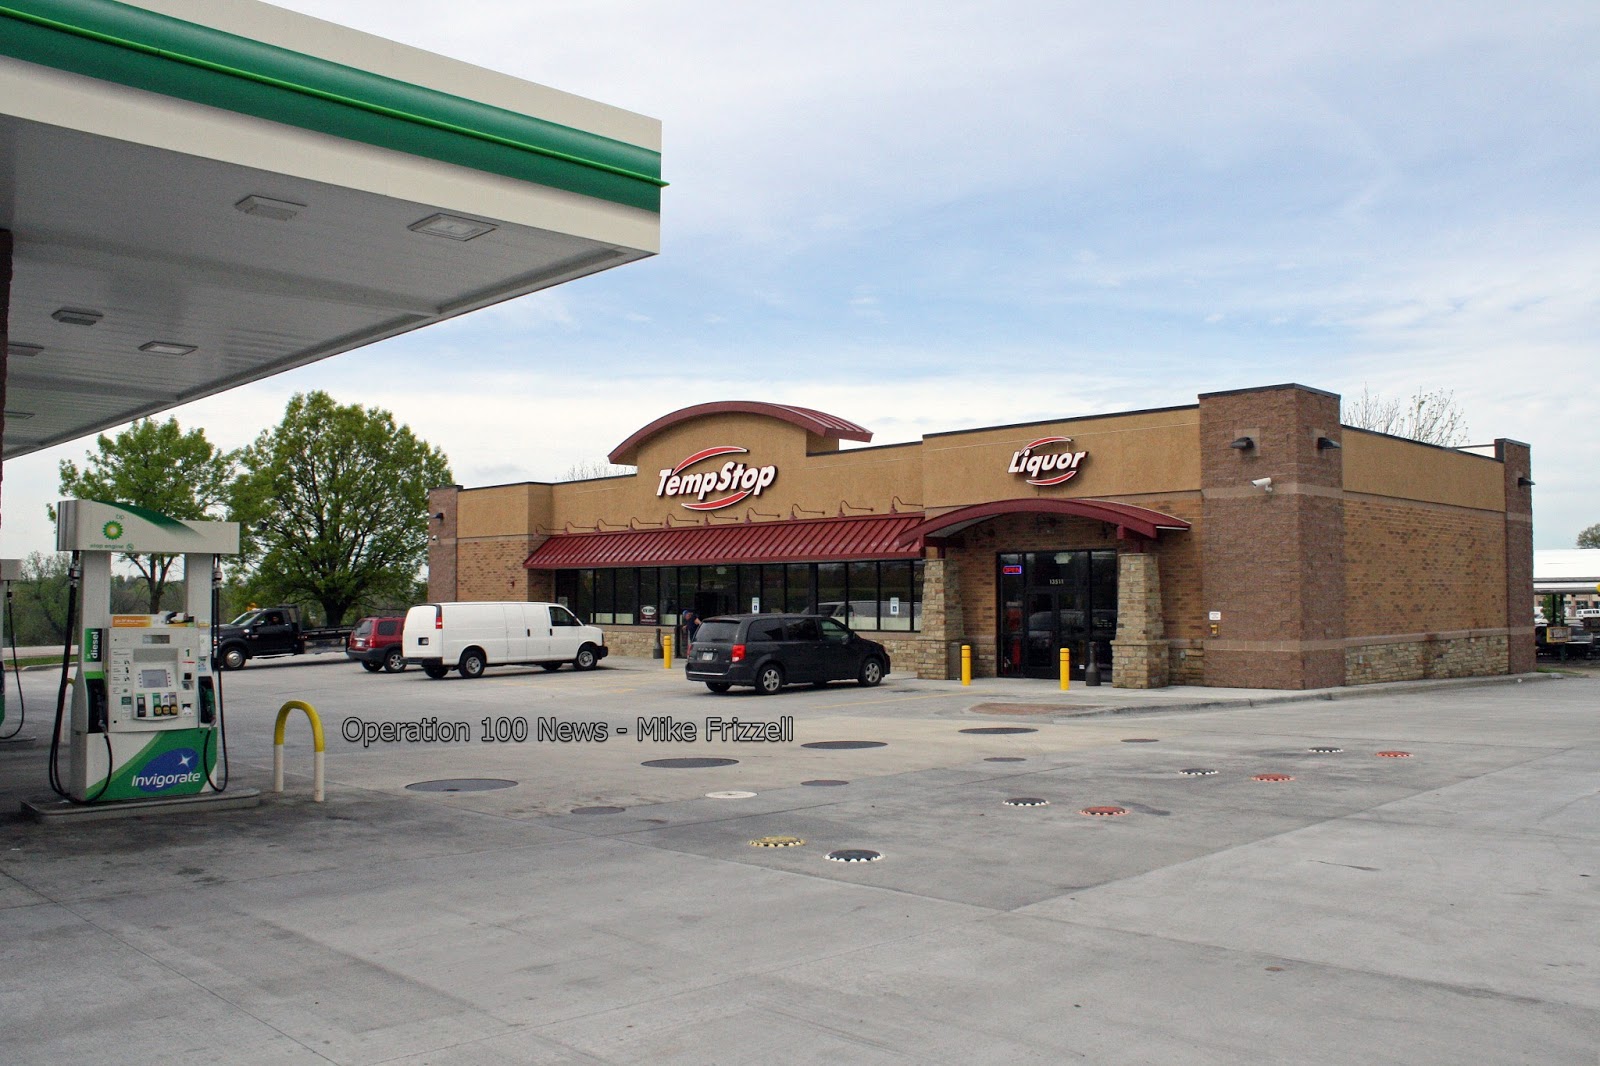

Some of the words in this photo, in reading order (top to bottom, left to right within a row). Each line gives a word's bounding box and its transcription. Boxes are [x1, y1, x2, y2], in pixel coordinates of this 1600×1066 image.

[1007, 449, 1087, 478] Liquor
[656, 461, 776, 500] TempStop
[90, 631, 99, 659] diesel
[185, 649, 190, 657] 1
[131, 771, 201, 788] Invigorate
